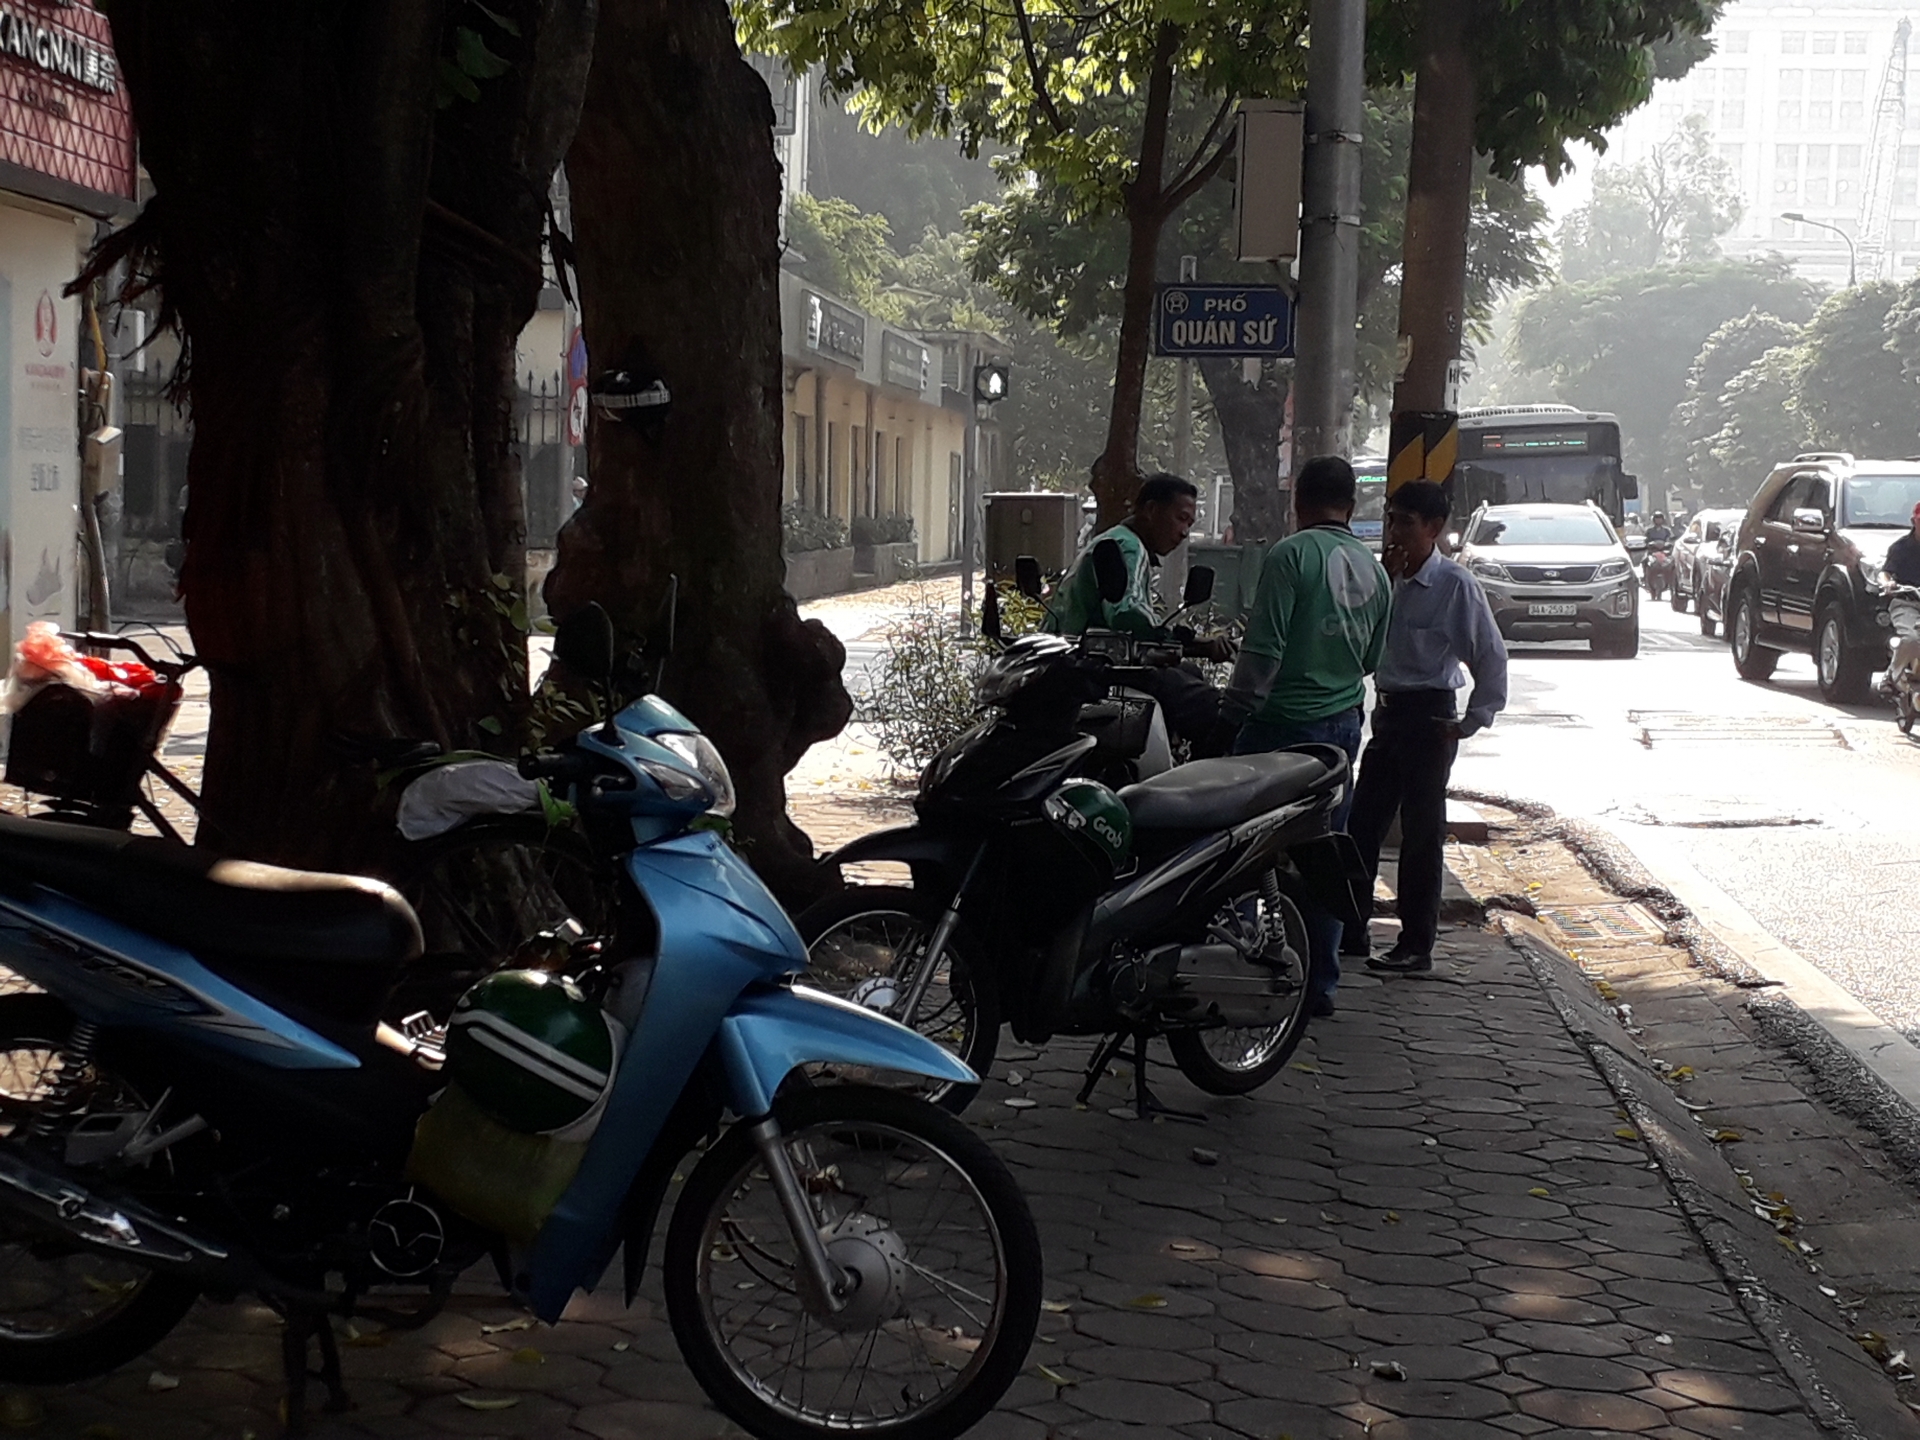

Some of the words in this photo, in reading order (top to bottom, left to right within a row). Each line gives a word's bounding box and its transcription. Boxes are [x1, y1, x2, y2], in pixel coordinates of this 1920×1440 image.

[1204, 293, 1247, 312] PHỐ
[1172, 314, 1236, 347] QUÁN
[1243, 313, 1278, 345] SỨ
[1093, 816, 1123, 849] Grab
